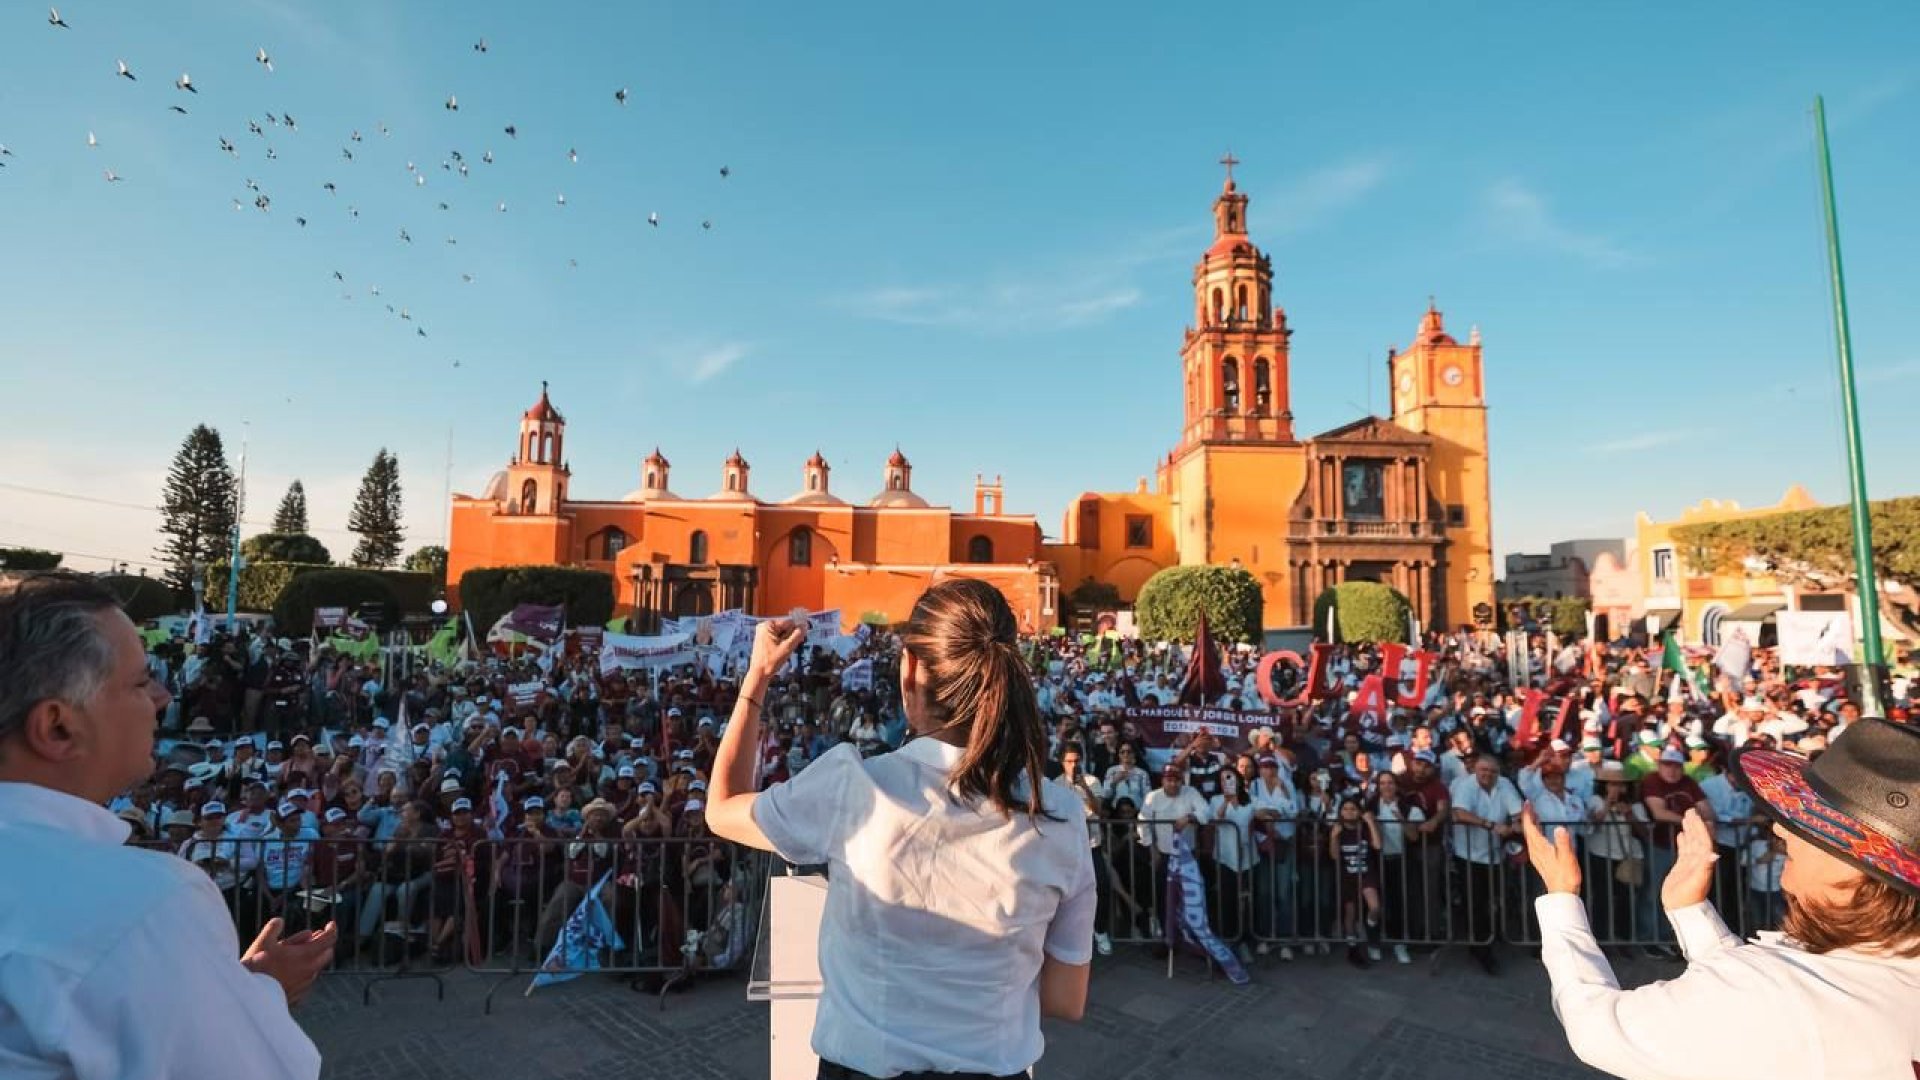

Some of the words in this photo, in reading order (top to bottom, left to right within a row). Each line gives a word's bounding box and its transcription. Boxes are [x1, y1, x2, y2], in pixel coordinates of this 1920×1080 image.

[1125, 707, 1138, 717] EL
[1193, 709, 1201, 718] Y
[1202, 710, 1237, 722] JORGE
